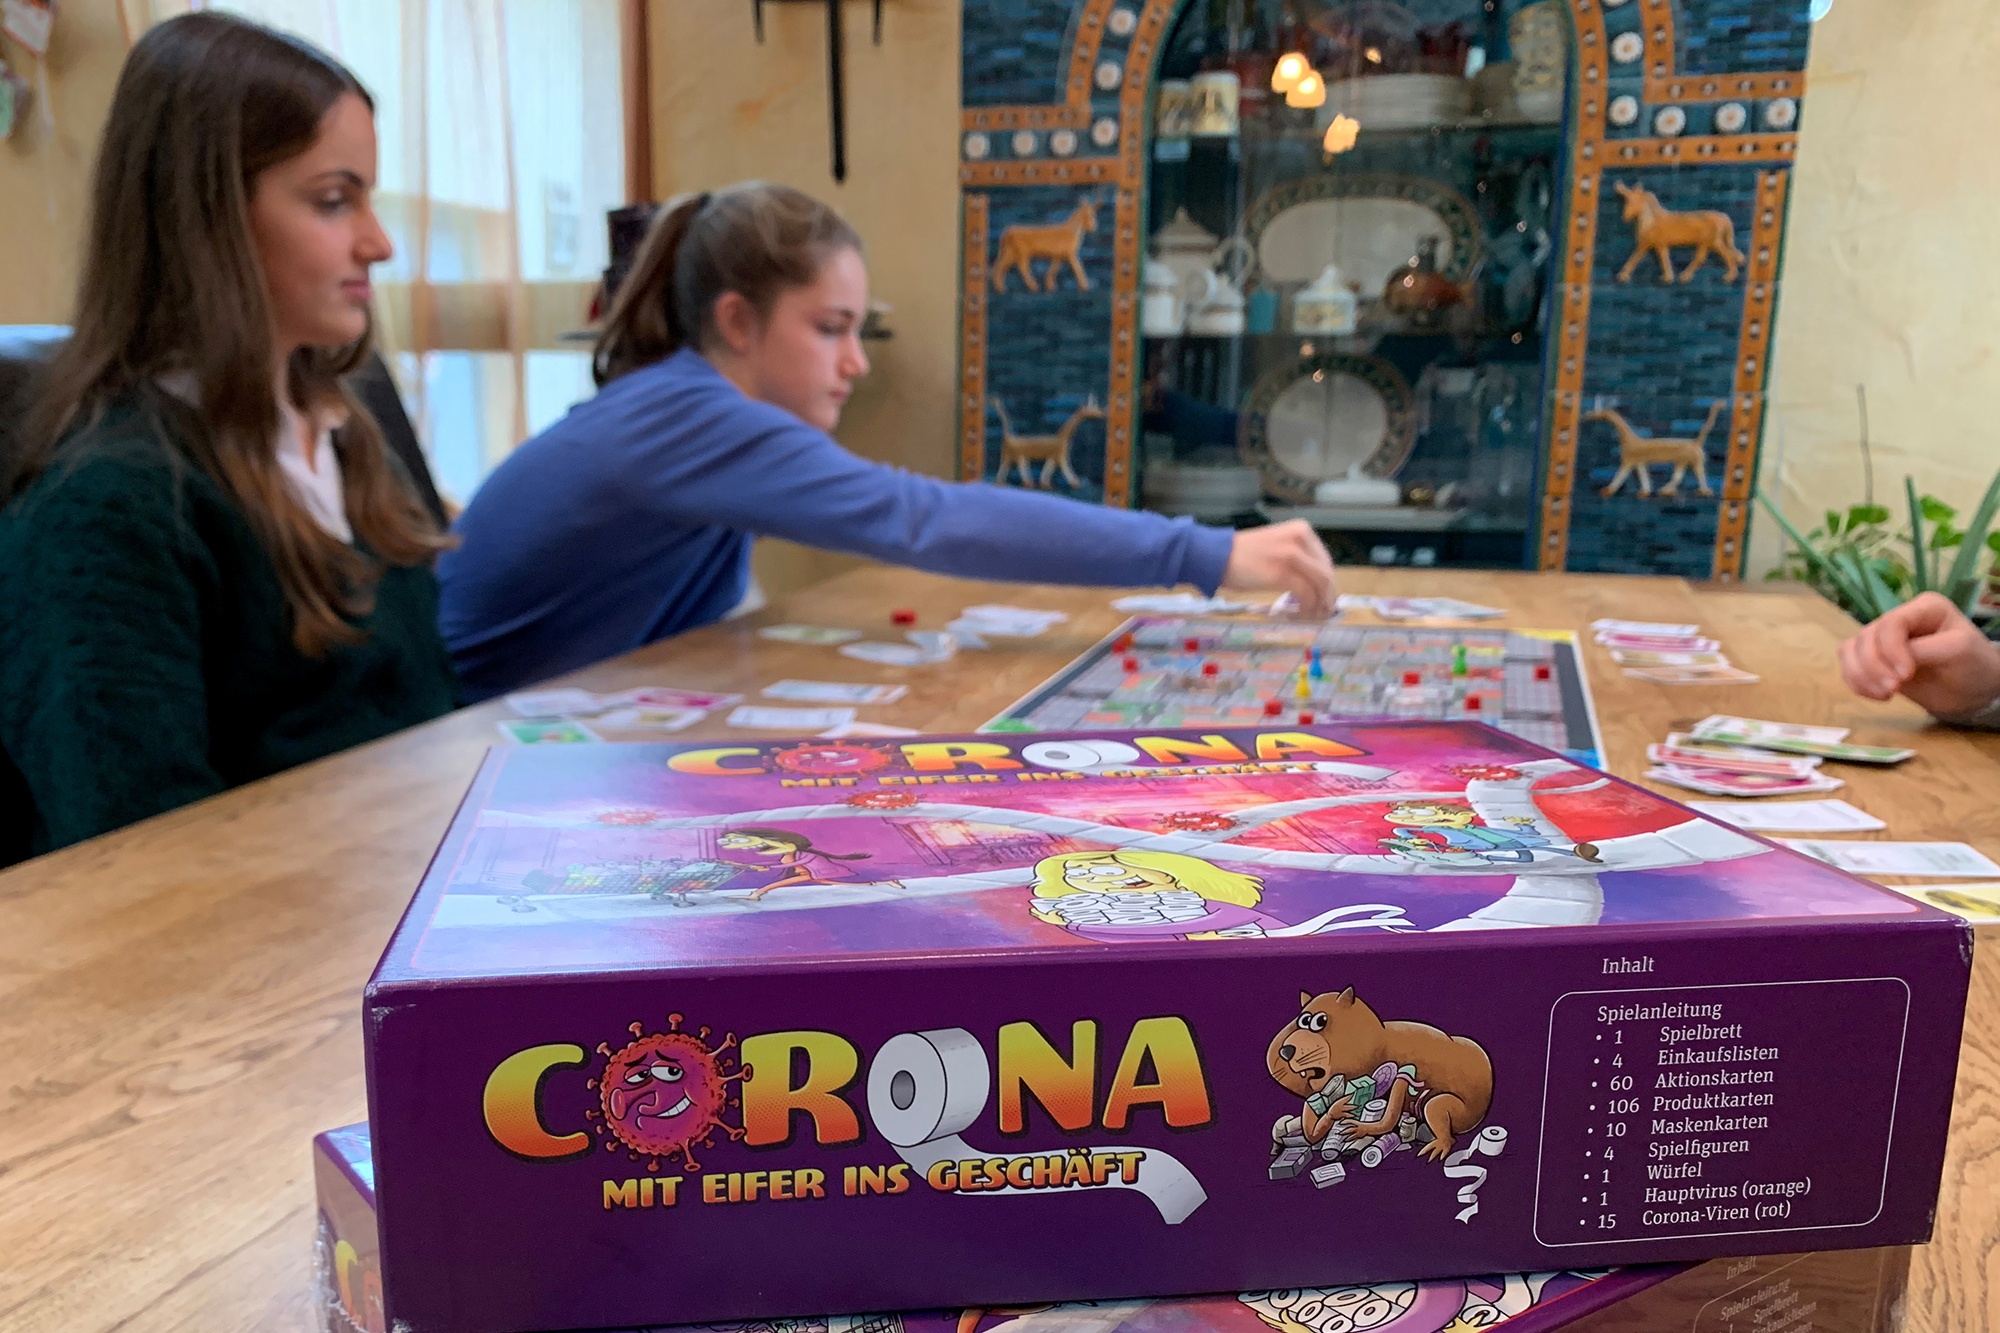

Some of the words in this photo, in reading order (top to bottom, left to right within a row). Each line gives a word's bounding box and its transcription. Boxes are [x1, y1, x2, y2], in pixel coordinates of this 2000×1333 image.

[779, 777, 857, 787] MIT
[877, 774, 1001, 785] EIFER
[1017, 770, 1085, 781] INS
[1601, 956, 1655, 974] Inhalt
[1597, 1002, 1723, 1025] Spielanleitung
[1614, 1030, 1623, 1044] 1
[1659, 1023, 1743, 1045] Spielbrett
[1612, 1053, 1623, 1069] 4
[1657, 1045, 1779, 1066] Einkaufslisten
[1610, 1075, 1633, 1091] 60
[1654, 1069, 1774, 1089] Aktionskarten
[1607, 1097, 1640, 1114] 106
[1652, 1092, 1774, 1112] Produktkarten
[1605, 1122, 1627, 1137] 10
[1650, 1115, 1769, 1135] Maskenkarten
[1603, 1146, 1615, 1161] 4
[1648, 1139, 1750, 1161] Spielfiguren
[603, 1175, 684, 1210] MIT
[702, 1167, 826, 1204] EIFER
[843, 1162, 910, 1197] INS
[926, 1148, 1146, 1193] GESCHÄFT
[1601, 1168, 1610, 1183] 1
[1646, 1162, 1703, 1181] Würfel
[1599, 1191, 1608, 1206] 1
[1644, 1184, 1738, 1204] Hauptvirus
[1742, 1177, 1812, 1199] (orange)
[1597, 1214, 1616, 1229] 15
[1642, 1205, 1749, 1226] Corona-Viren
[1754, 1201, 1791, 1221] (rot)
[1726, 1256, 1757, 1280] Inhalt
